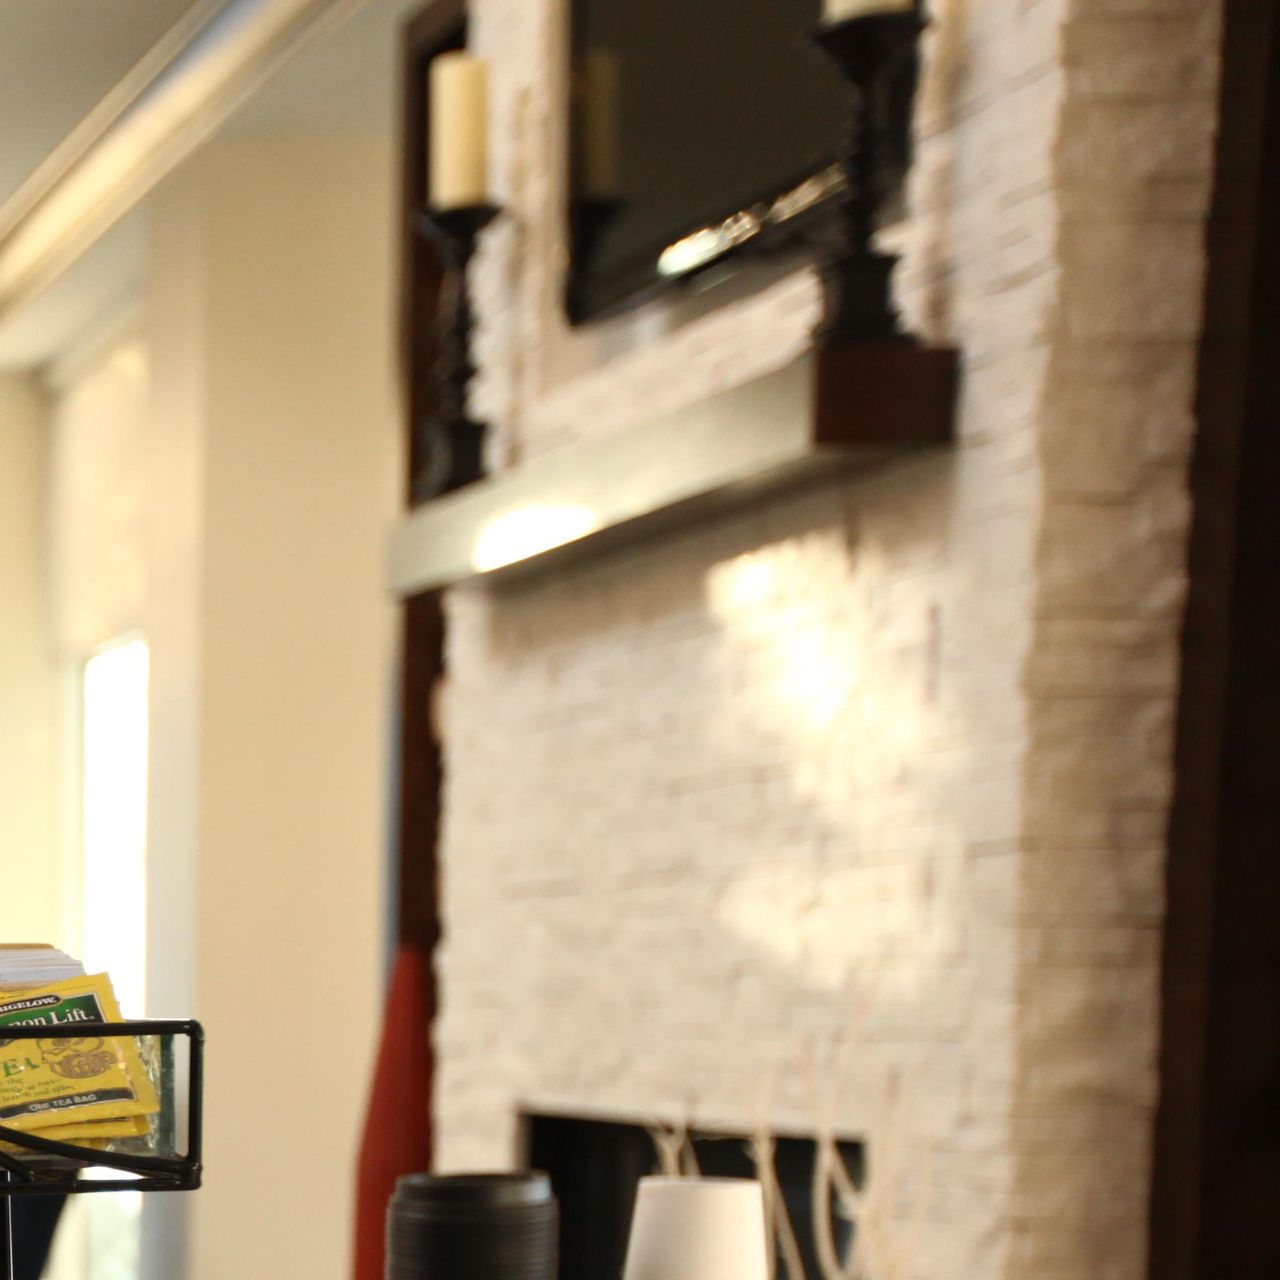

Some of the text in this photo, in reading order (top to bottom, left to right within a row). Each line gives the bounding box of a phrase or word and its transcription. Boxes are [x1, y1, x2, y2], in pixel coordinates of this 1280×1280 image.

[49, 1008, 90, 1024] Lift
[52, 1097, 73, 1107] TEA
[74, 1093, 97, 1104] BAG
